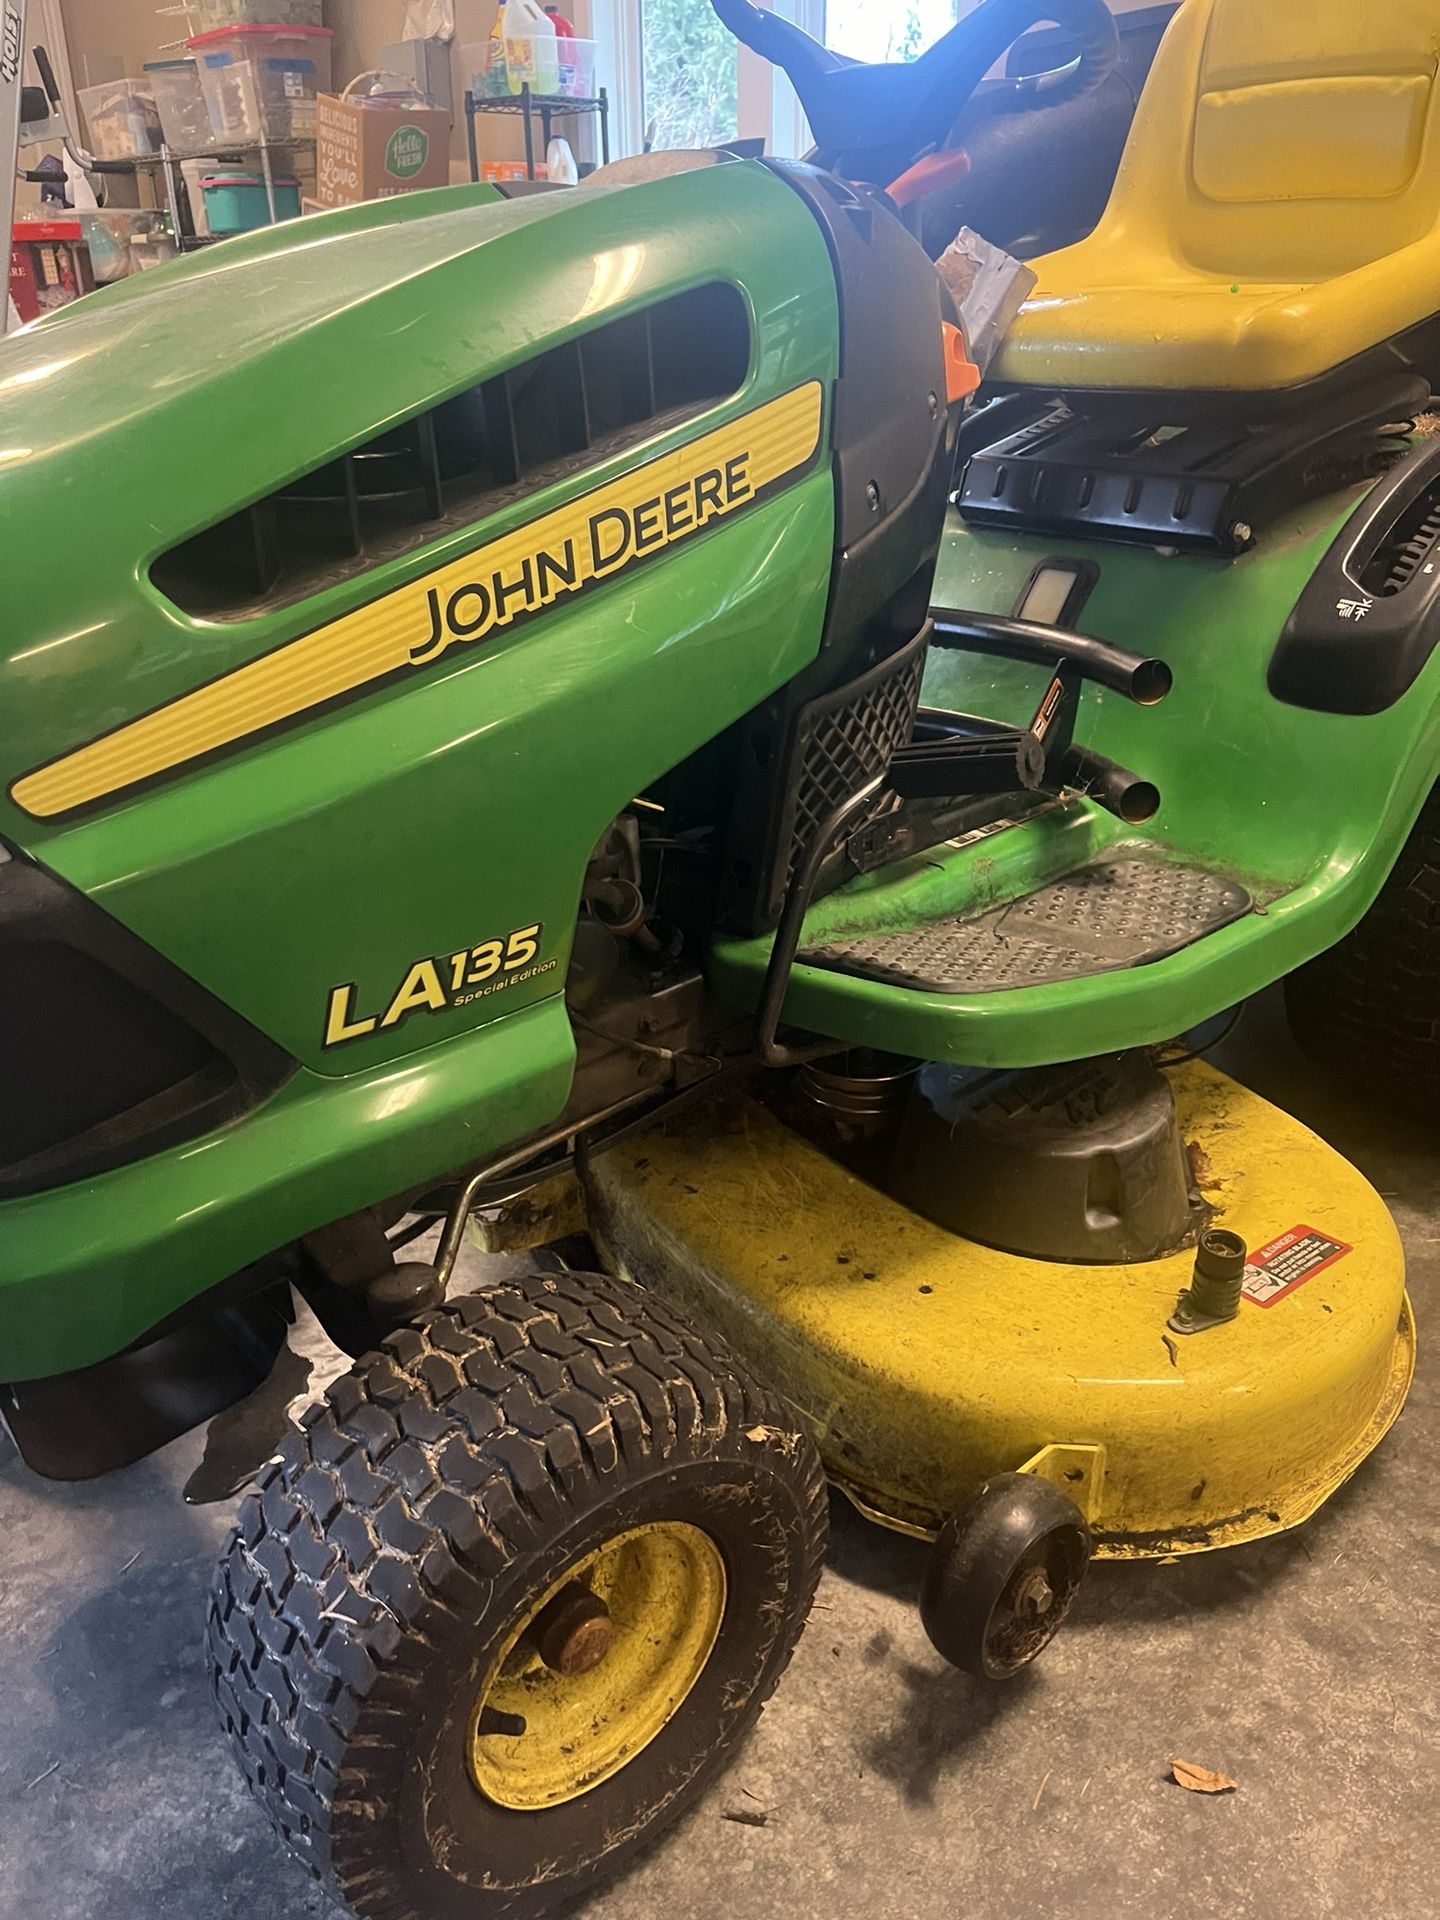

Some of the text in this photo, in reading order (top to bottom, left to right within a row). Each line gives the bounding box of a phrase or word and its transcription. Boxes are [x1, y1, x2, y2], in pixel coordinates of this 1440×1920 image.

[1, 0, 18, 83] HOIST
[320, 140, 358, 167] YOU'LL
[392, 134, 422, 160] Hello
[320, 157, 359, 189] Love
[320, 186, 333, 202] TO
[408, 450, 752, 660] JOHN DEERE
[453, 959, 557, 1007] Special Edition
[1266, 1233, 1297, 1254] DANGER
